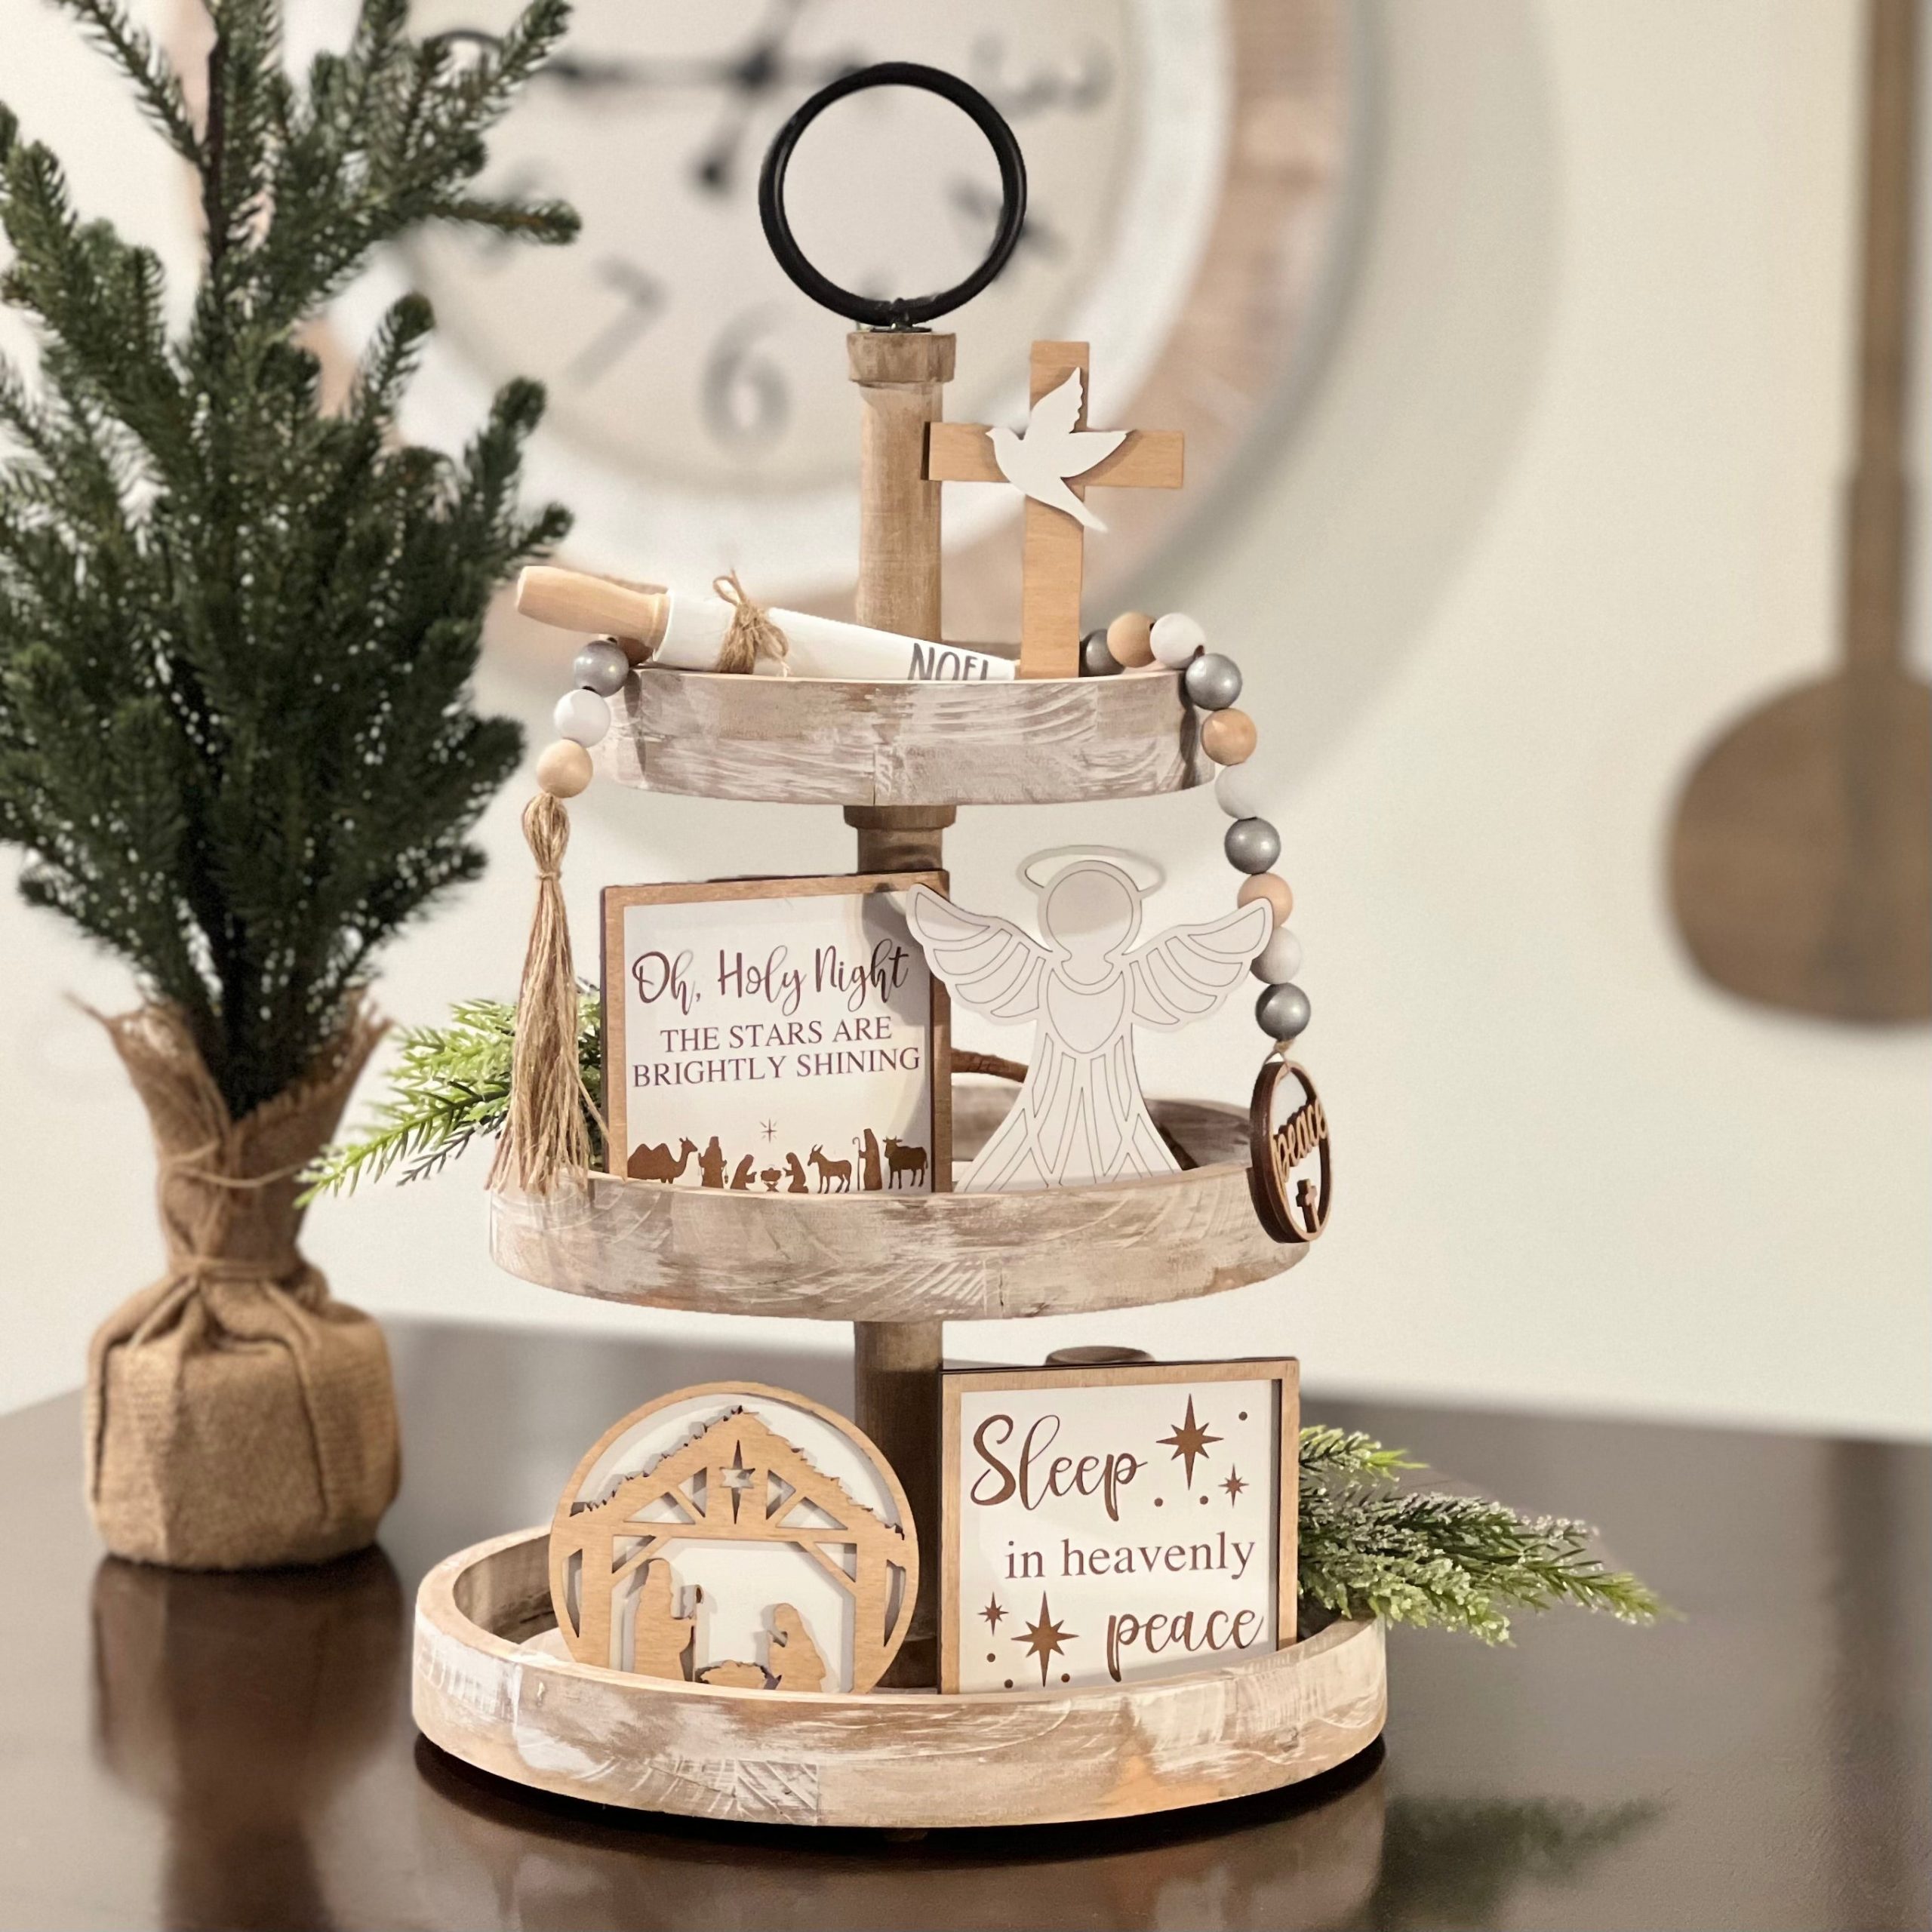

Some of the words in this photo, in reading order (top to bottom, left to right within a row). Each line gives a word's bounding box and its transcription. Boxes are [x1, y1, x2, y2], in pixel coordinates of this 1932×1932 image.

[630, 950, 701, 1015] Oh,
[718, 945, 807, 1016] Holy
[815, 938, 909, 1012] Night
[633, 1056, 786, 1087] BRIGHTLY
[796, 1047, 919, 1077] SHINING
[660, 1027, 719, 1053] THE
[729, 1020, 823, 1048] STARS
[832, 1017, 892, 1042] ARE
[1272, 1097, 1327, 1183] peace
[970, 1414, 1148, 1521] Sleep
[1004, 1540, 1045, 1579] in
[1060, 1531, 1256, 1580] heavenly
[1106, 1609, 1264, 1683] peace
